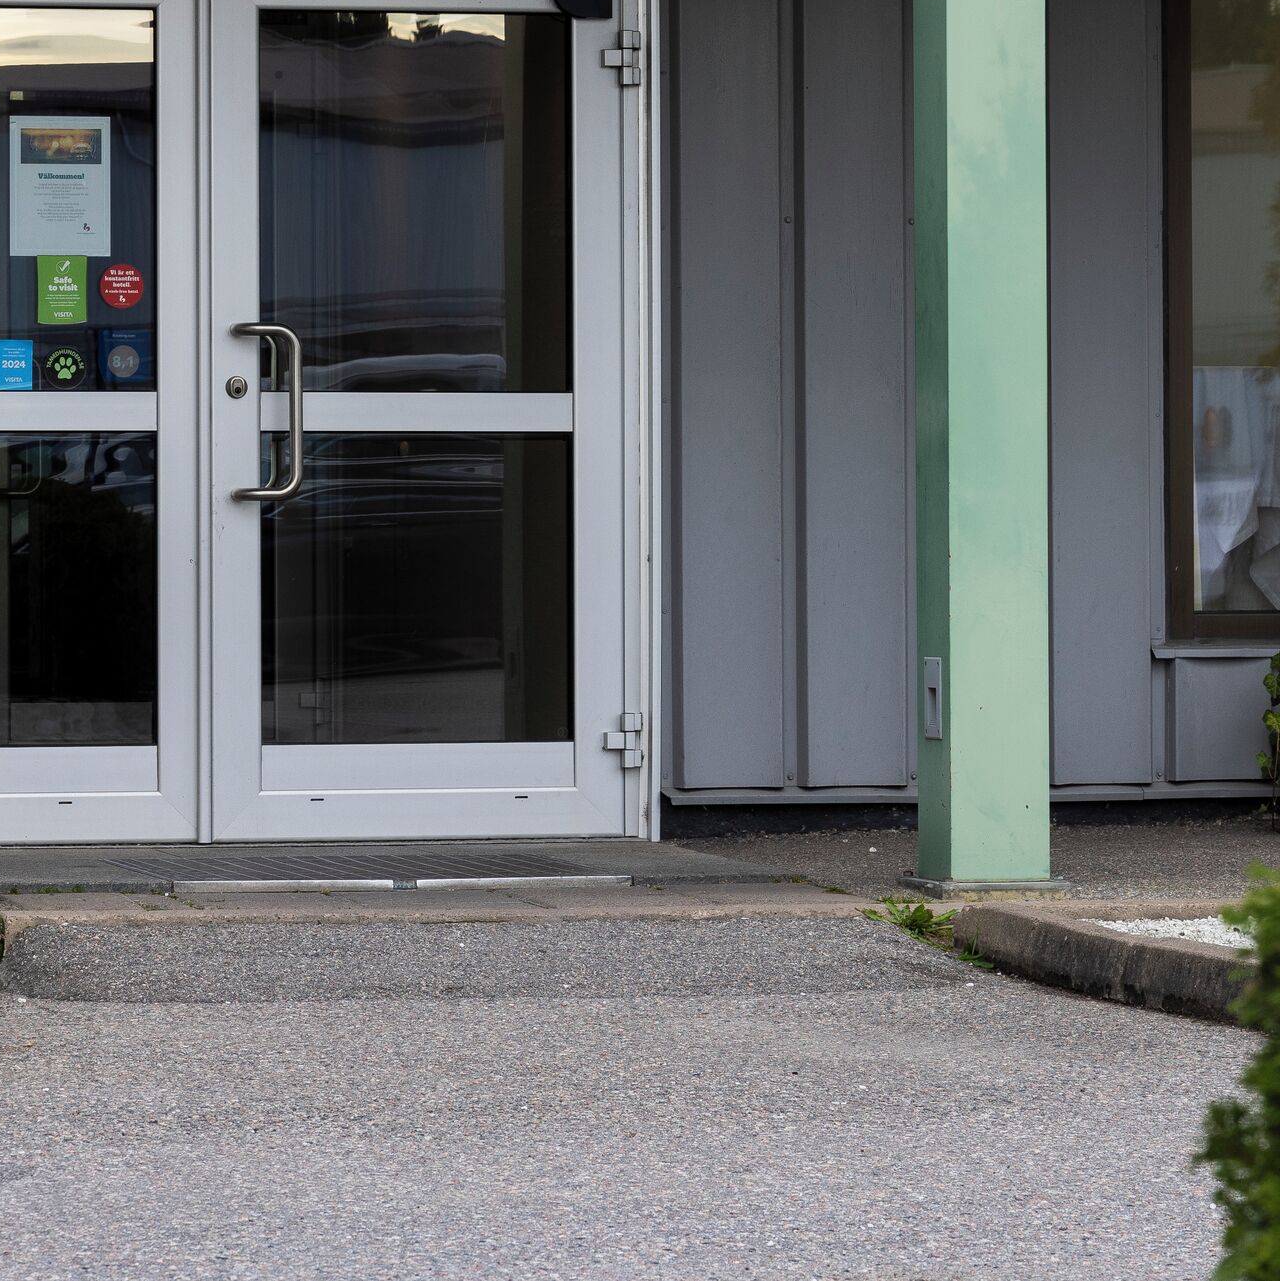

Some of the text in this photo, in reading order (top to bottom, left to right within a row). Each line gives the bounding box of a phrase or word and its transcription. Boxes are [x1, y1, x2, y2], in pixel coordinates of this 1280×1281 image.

[38, 172, 85, 180] Välkommen!
[53, 276, 73, 284] Safe
[59, 283, 79, 291] visit
[1, 360, 26, 369] 2024
[112, 355, 134, 369] 8,1
